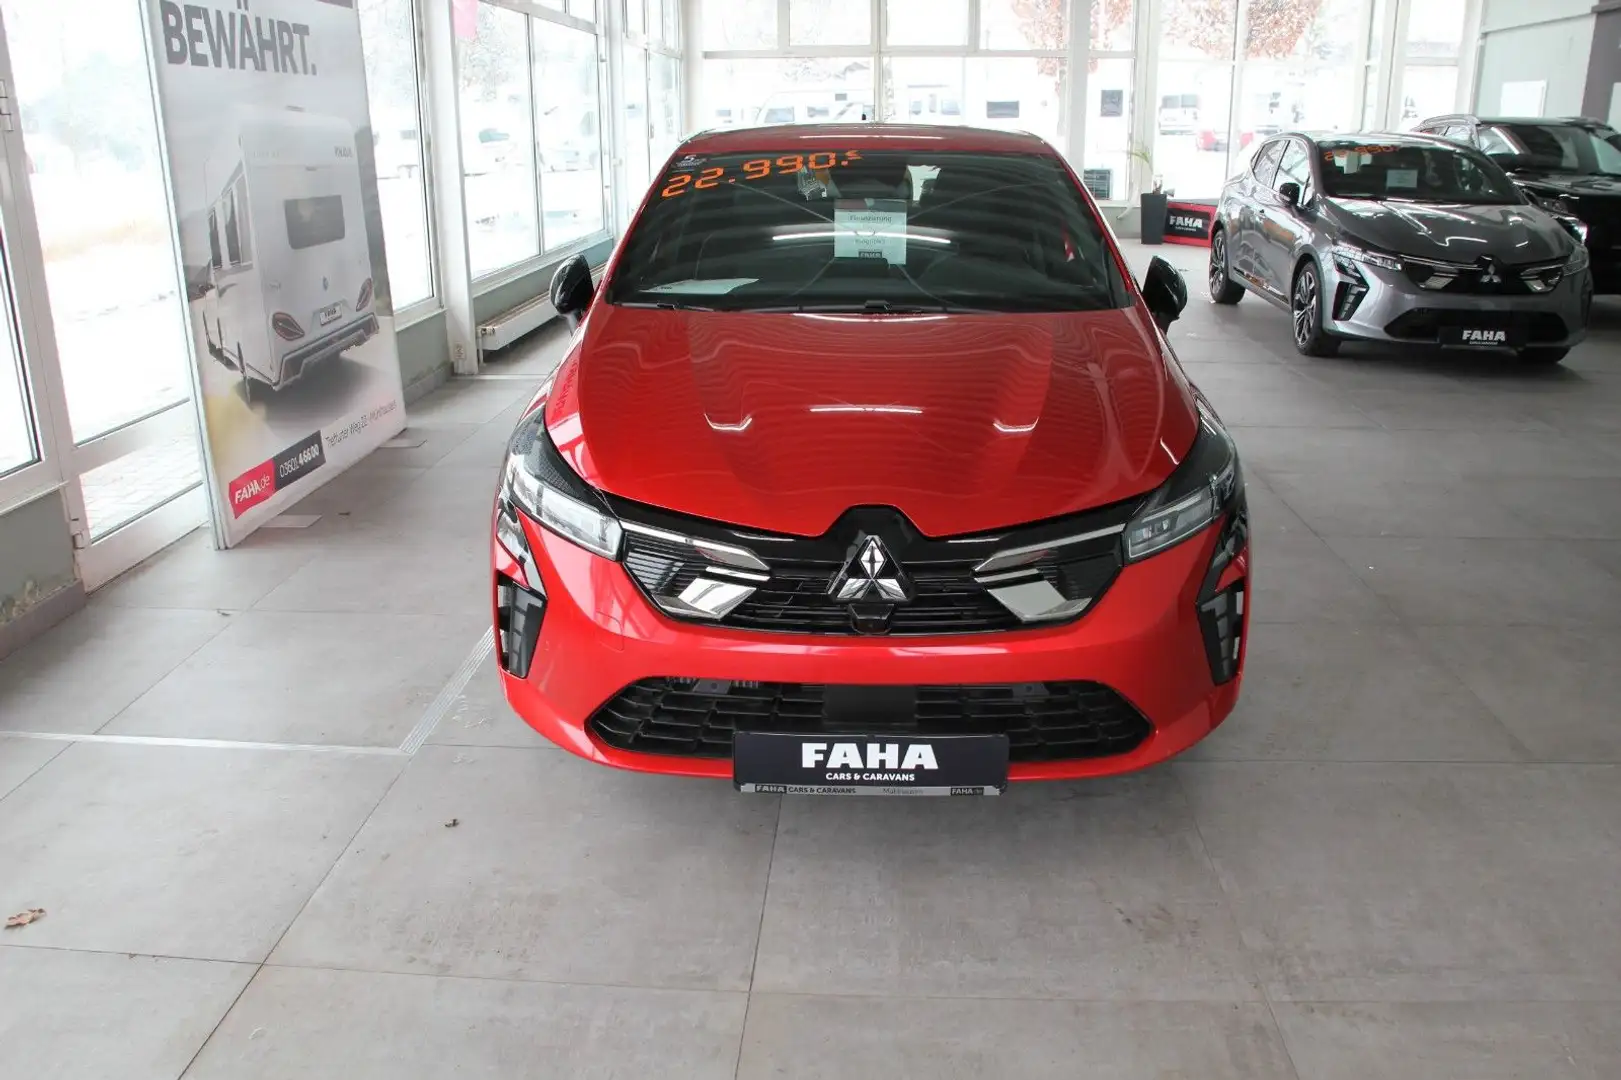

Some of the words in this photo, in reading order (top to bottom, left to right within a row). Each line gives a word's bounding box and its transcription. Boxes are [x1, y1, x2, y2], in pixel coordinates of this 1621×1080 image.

[160, 0, 317, 76] BEWÄHRT.
[1169, 215, 1203, 228] FAHA
[1461, 330, 1506, 342] FAHA
[234, 474, 271, 504] FAHA.de
[801, 742, 939, 770] FAHA
[825, 772, 852, 781] CARS
[853, 773, 861, 781] &
[862, 772, 916, 782] CARAVANS
[756, 784, 786, 793] FAHA
[788, 786, 808, 794] CARS
[816, 786, 857, 794] CARAVANS
